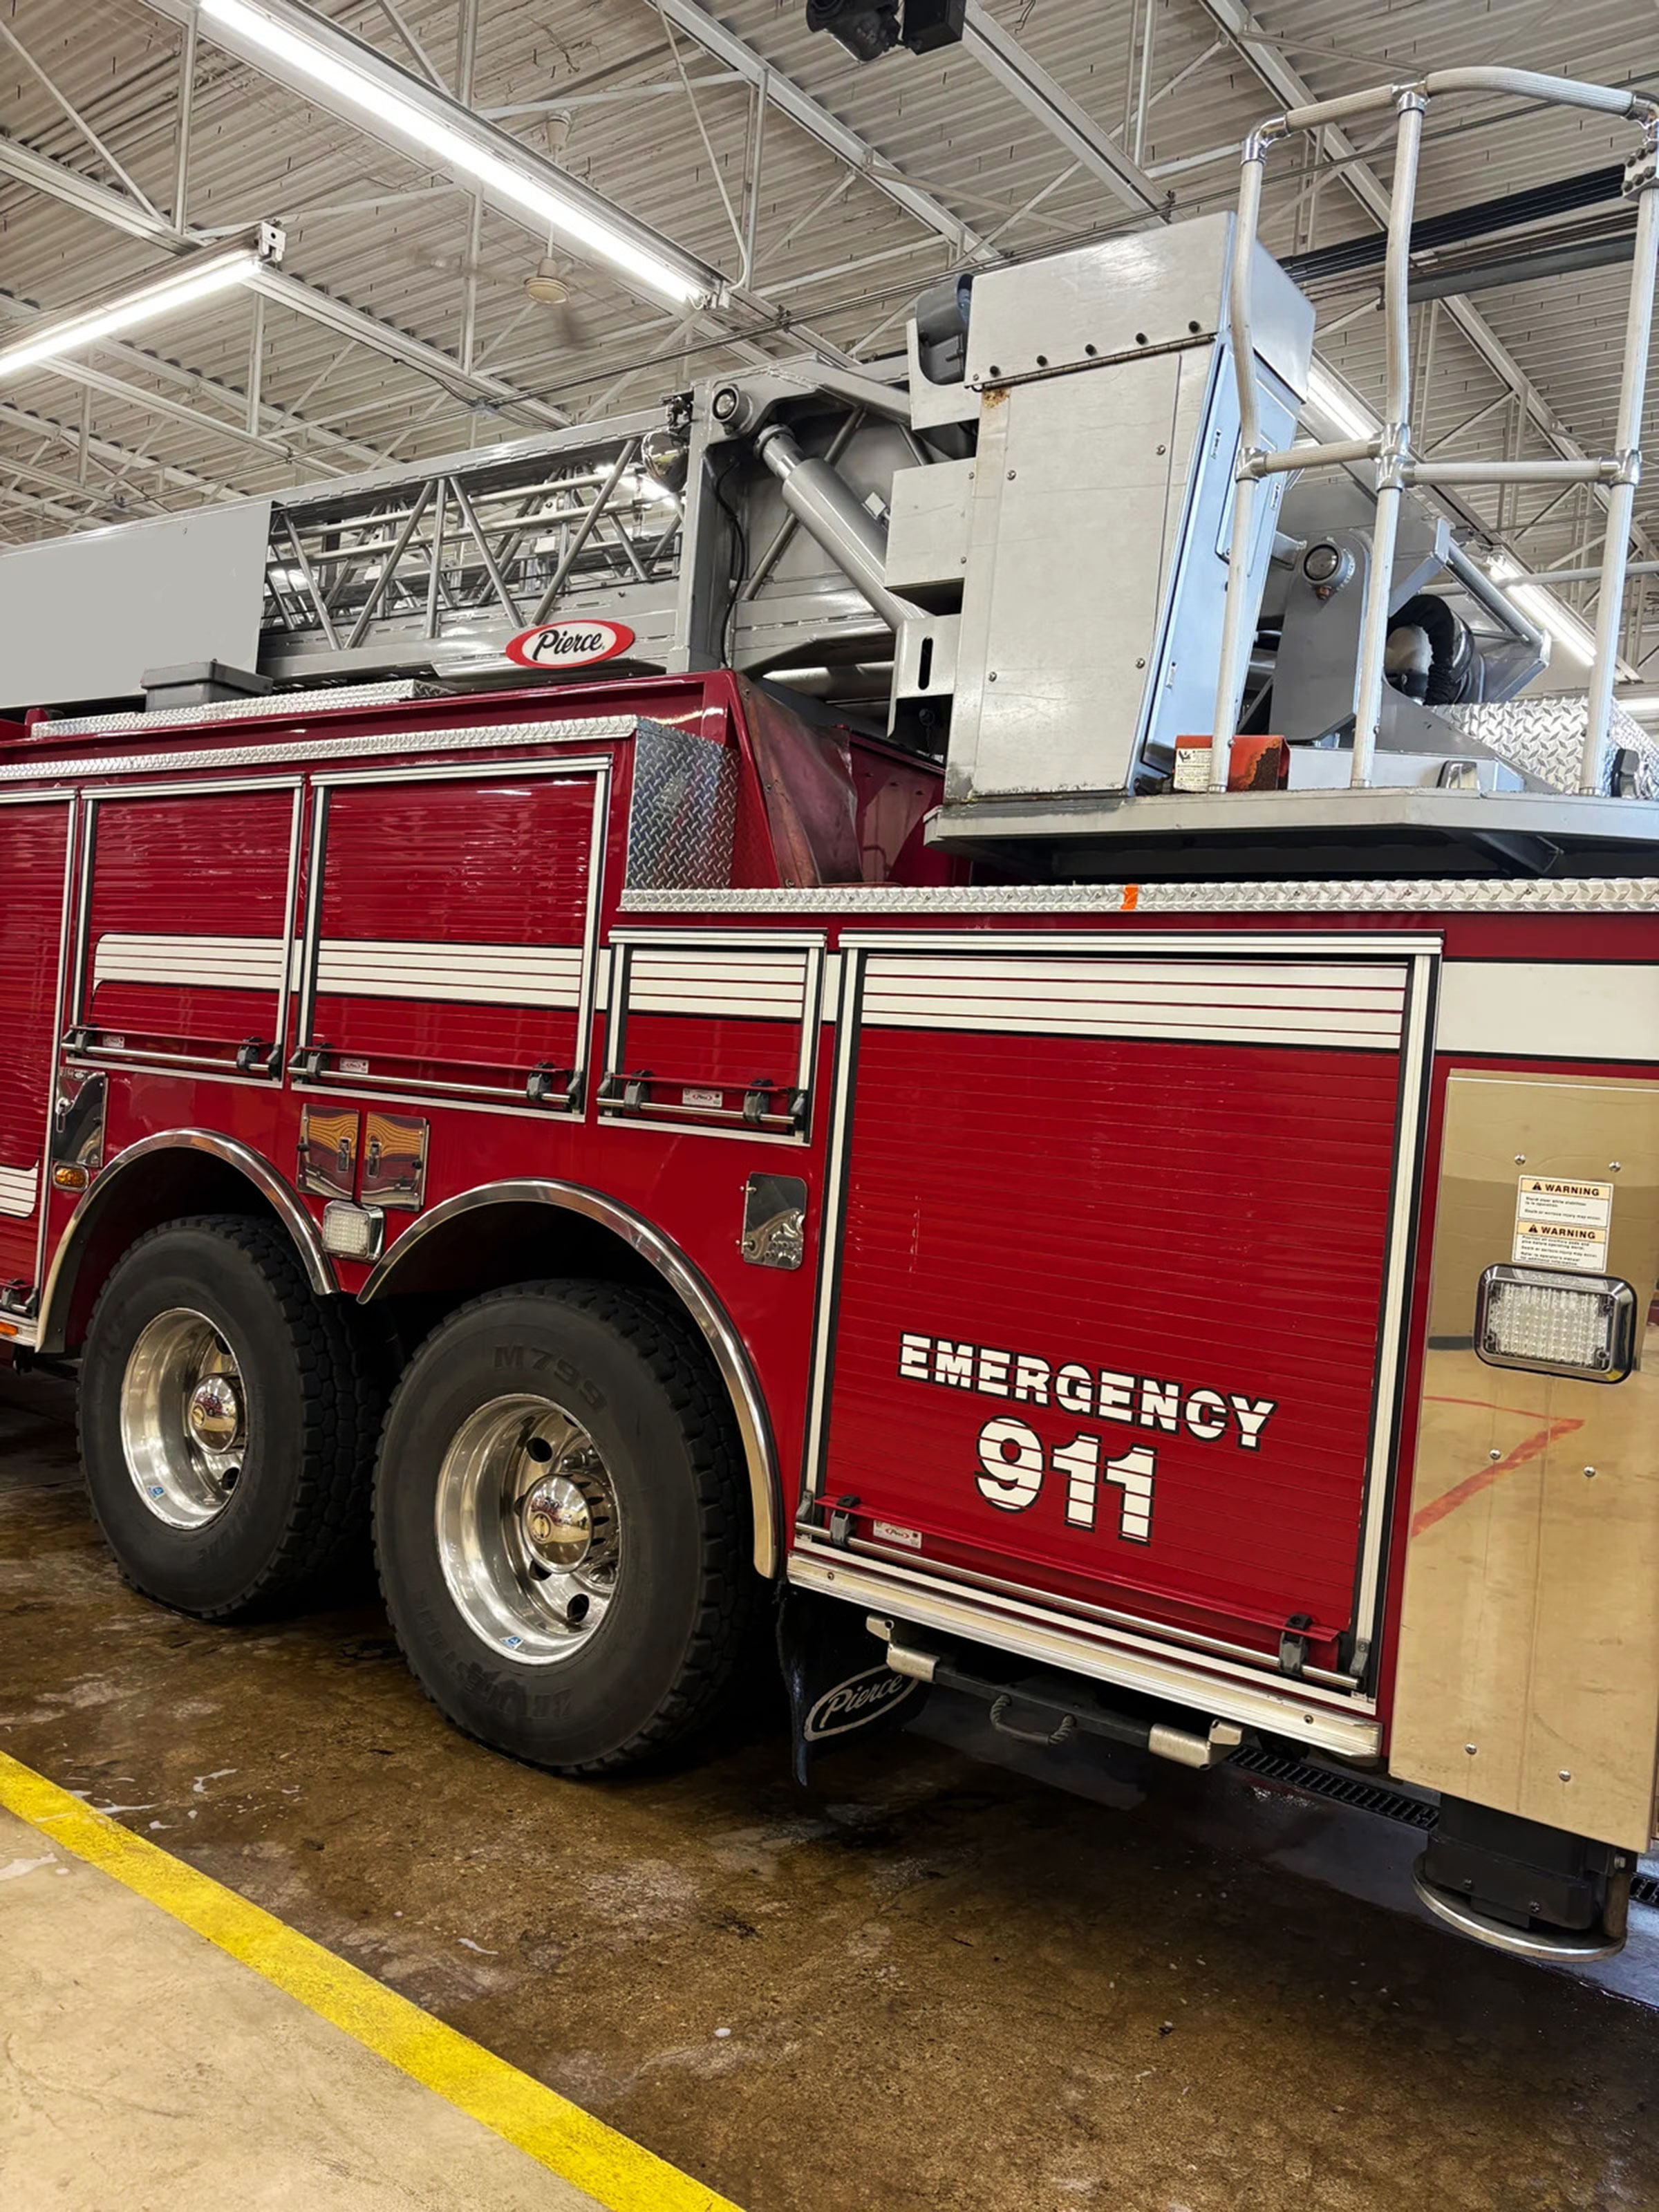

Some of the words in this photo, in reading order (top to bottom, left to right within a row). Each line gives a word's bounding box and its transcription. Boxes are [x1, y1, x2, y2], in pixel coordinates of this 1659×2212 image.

[532, 629, 603, 661] Pierce
[1545, 1183, 1600, 1197] WARNING
[1541, 1226, 1596, 1239] WARNING
[899, 1333, 1277, 1450] EMERGENCY
[975, 1416, 1156, 1545] 911
[819, 1674, 903, 1729] Pierce
